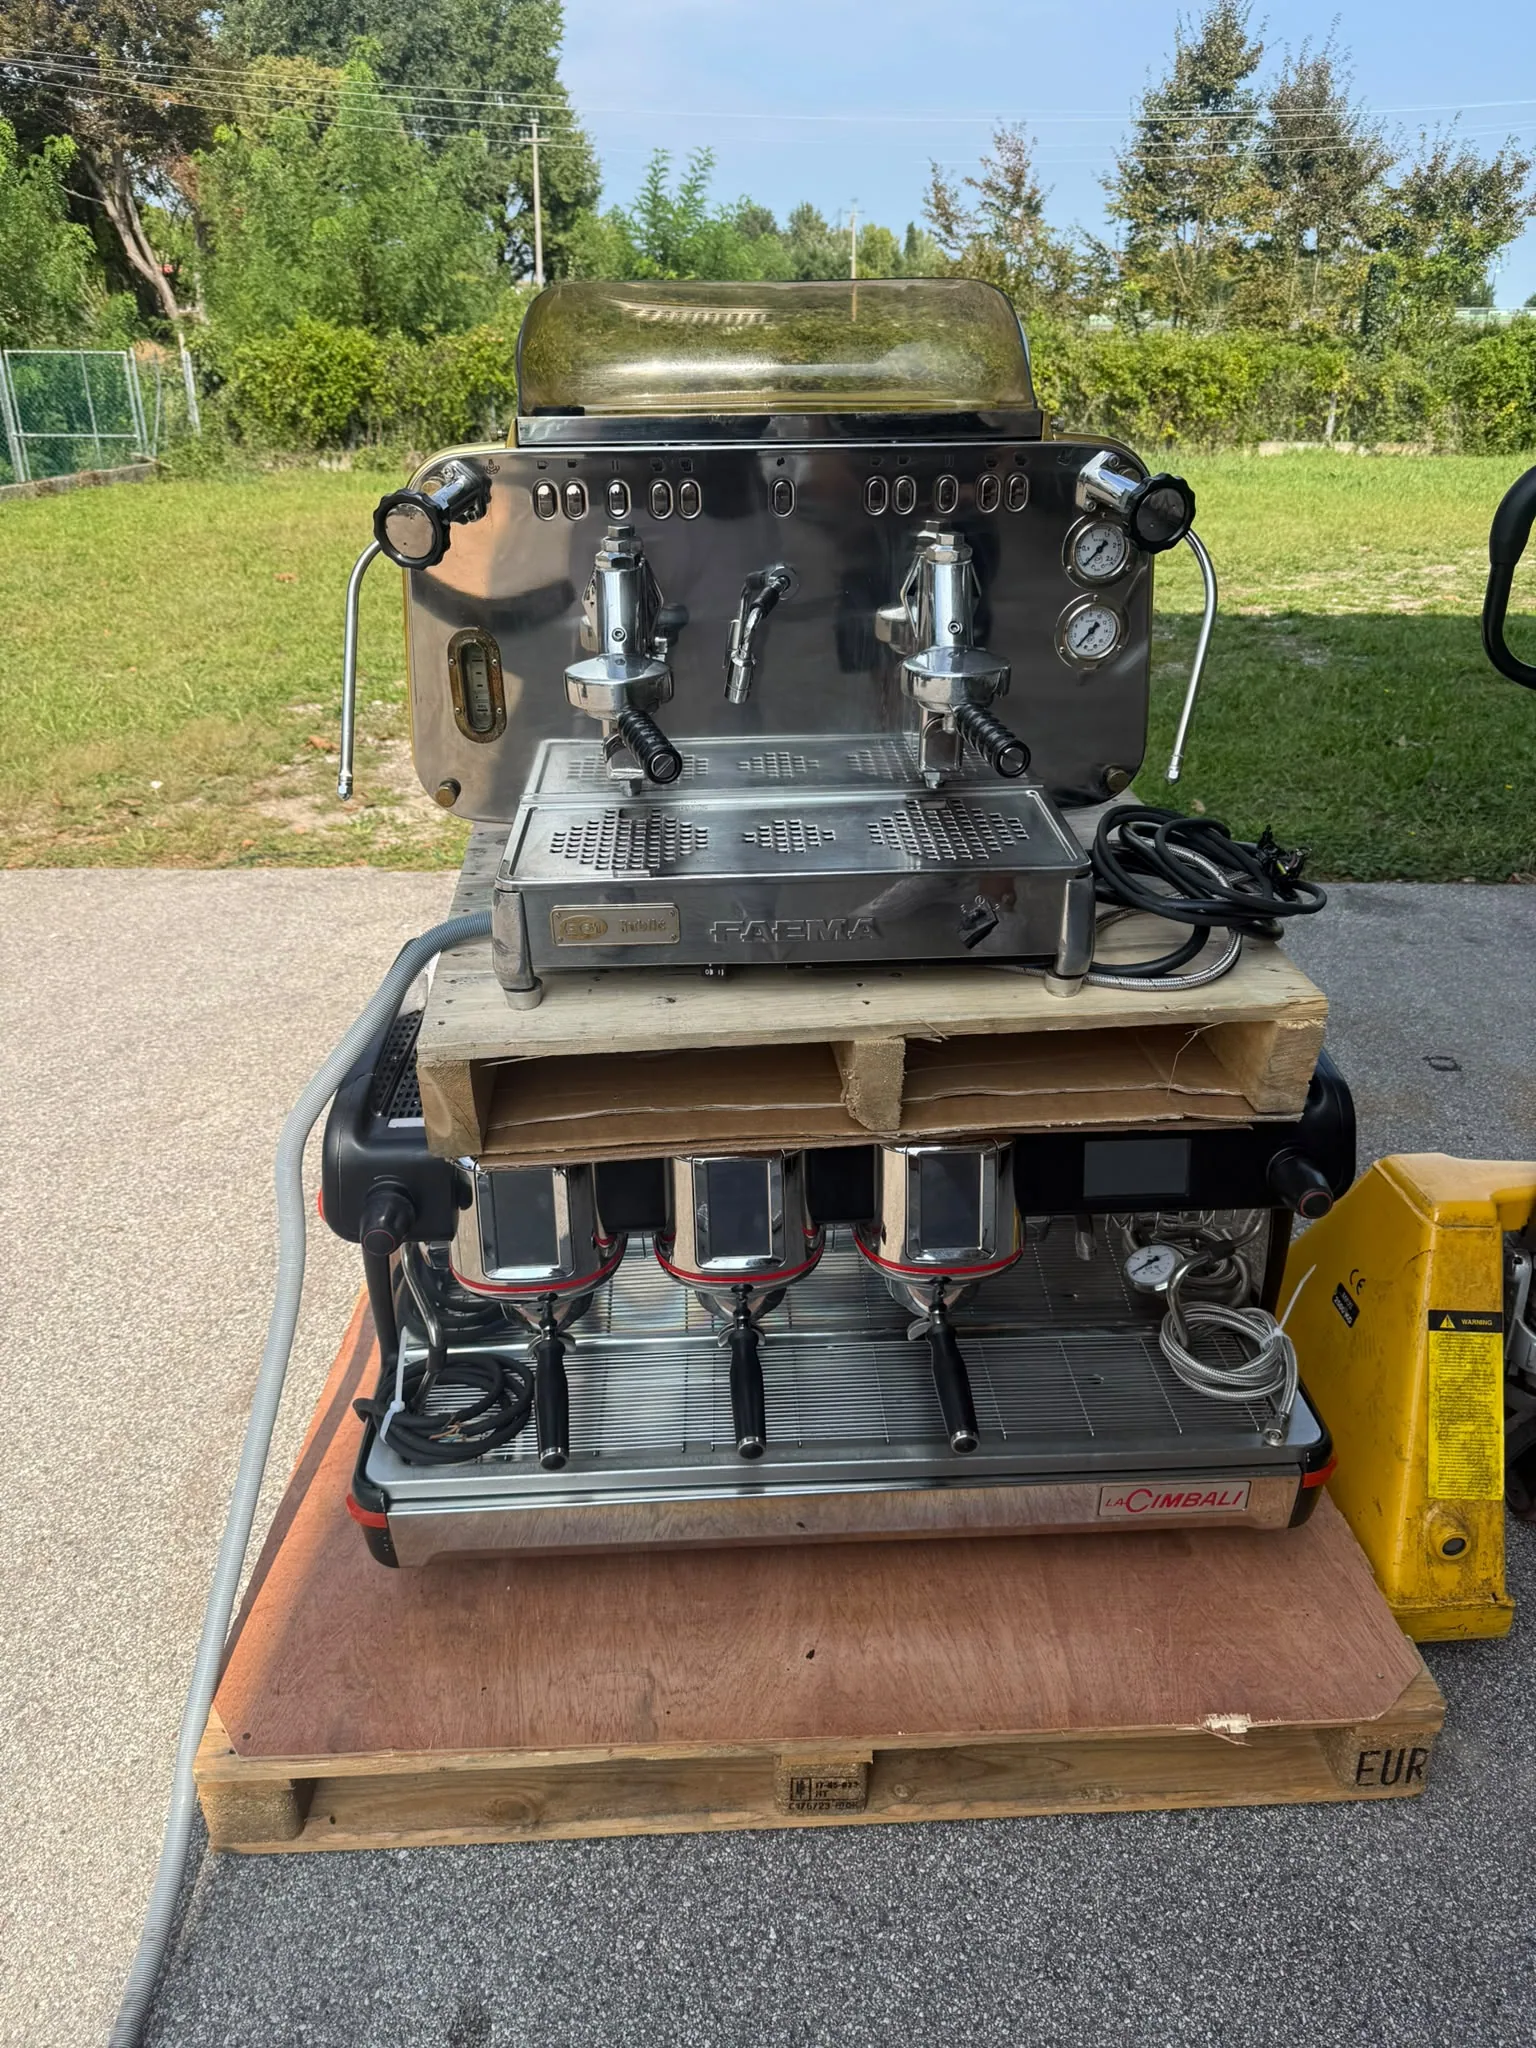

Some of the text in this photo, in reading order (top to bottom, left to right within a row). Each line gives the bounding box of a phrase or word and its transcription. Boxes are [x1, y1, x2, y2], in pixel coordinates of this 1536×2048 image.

[709, 917, 884, 943] FAEMA
[1461, 1318, 1493, 1326] WARNING
[1105, 1488, 1244, 1513] LA CIMBALI
[1356, 1747, 1429, 1787] EUR
[815, 1790, 829, 1798] HT
